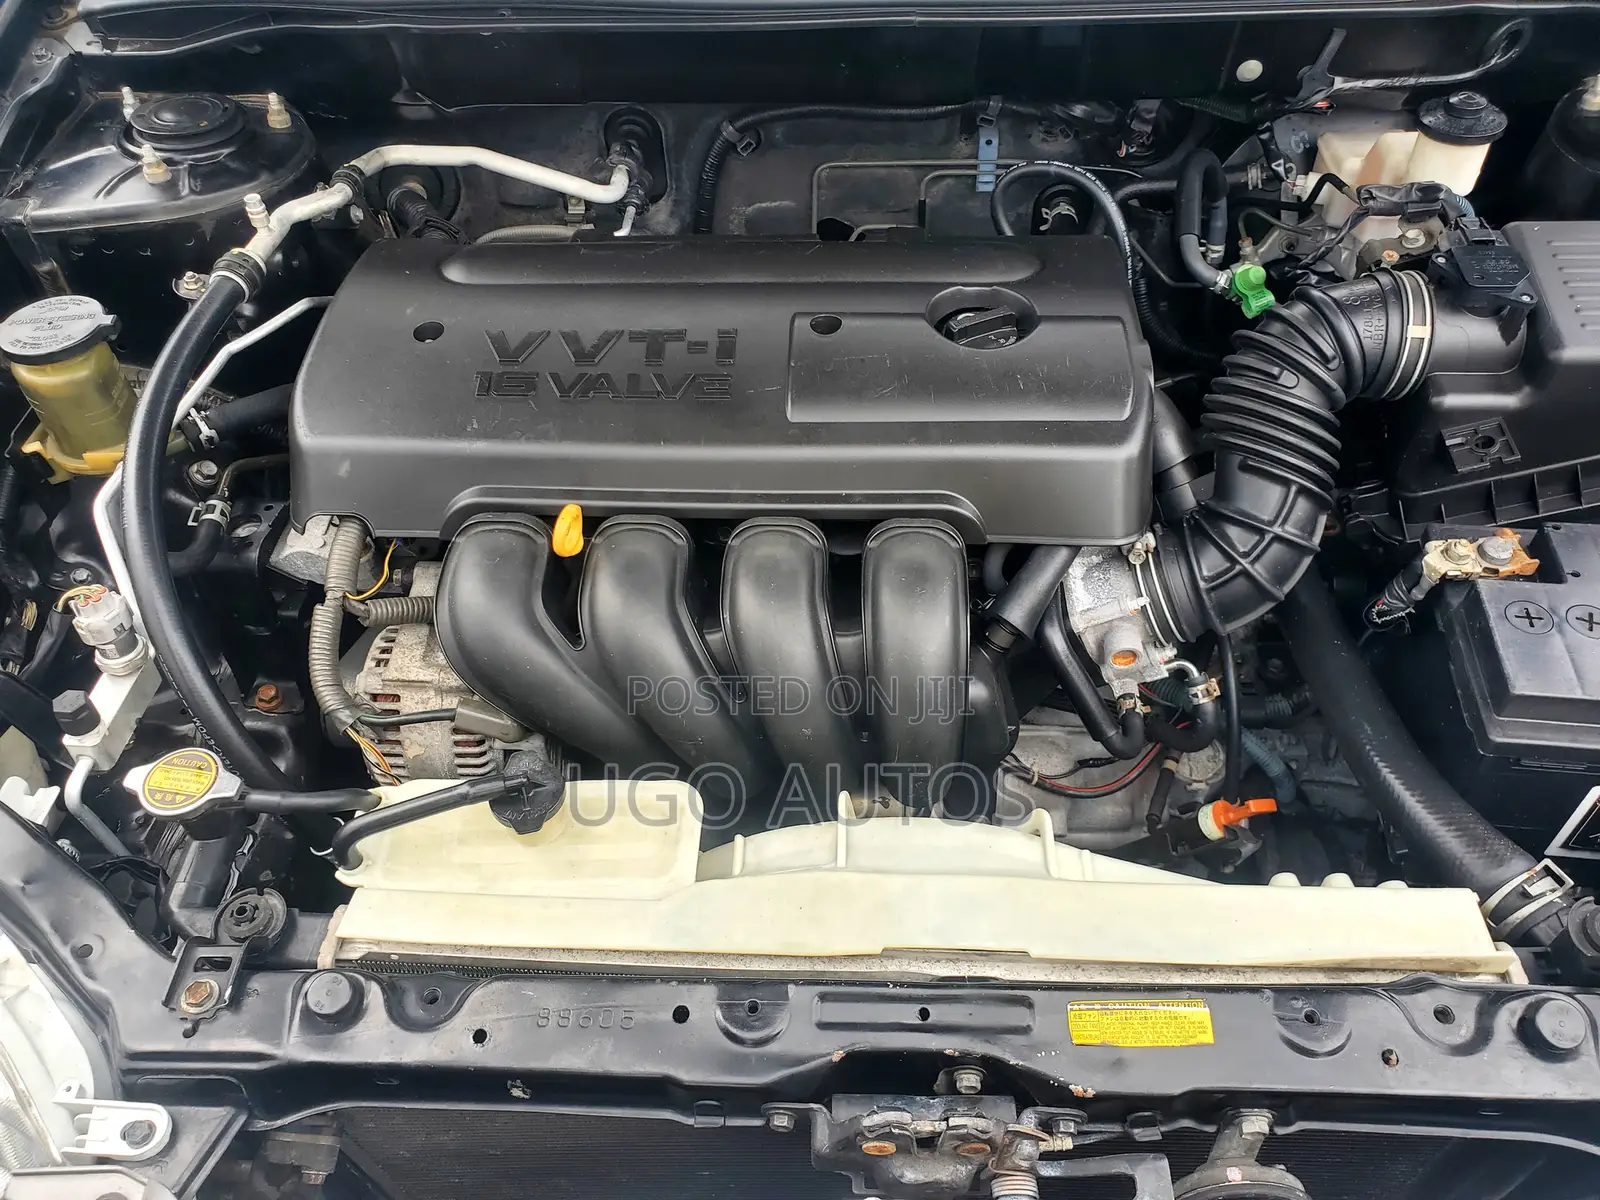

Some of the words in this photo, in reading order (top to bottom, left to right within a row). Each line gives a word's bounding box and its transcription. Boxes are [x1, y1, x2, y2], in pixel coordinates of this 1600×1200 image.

[8, 317, 46, 326] POWER
[33, 324, 63, 332] FLUID
[474, 371, 539, 397] 16
[545, 372, 733, 400] VALVE
[171, 756, 208, 769] CAUTION
[1108, 1002, 1150, 1010] CAUTION
[1158, 1001, 1205, 1009] ATTENTION
[536, 1007, 636, 1031] 88605
